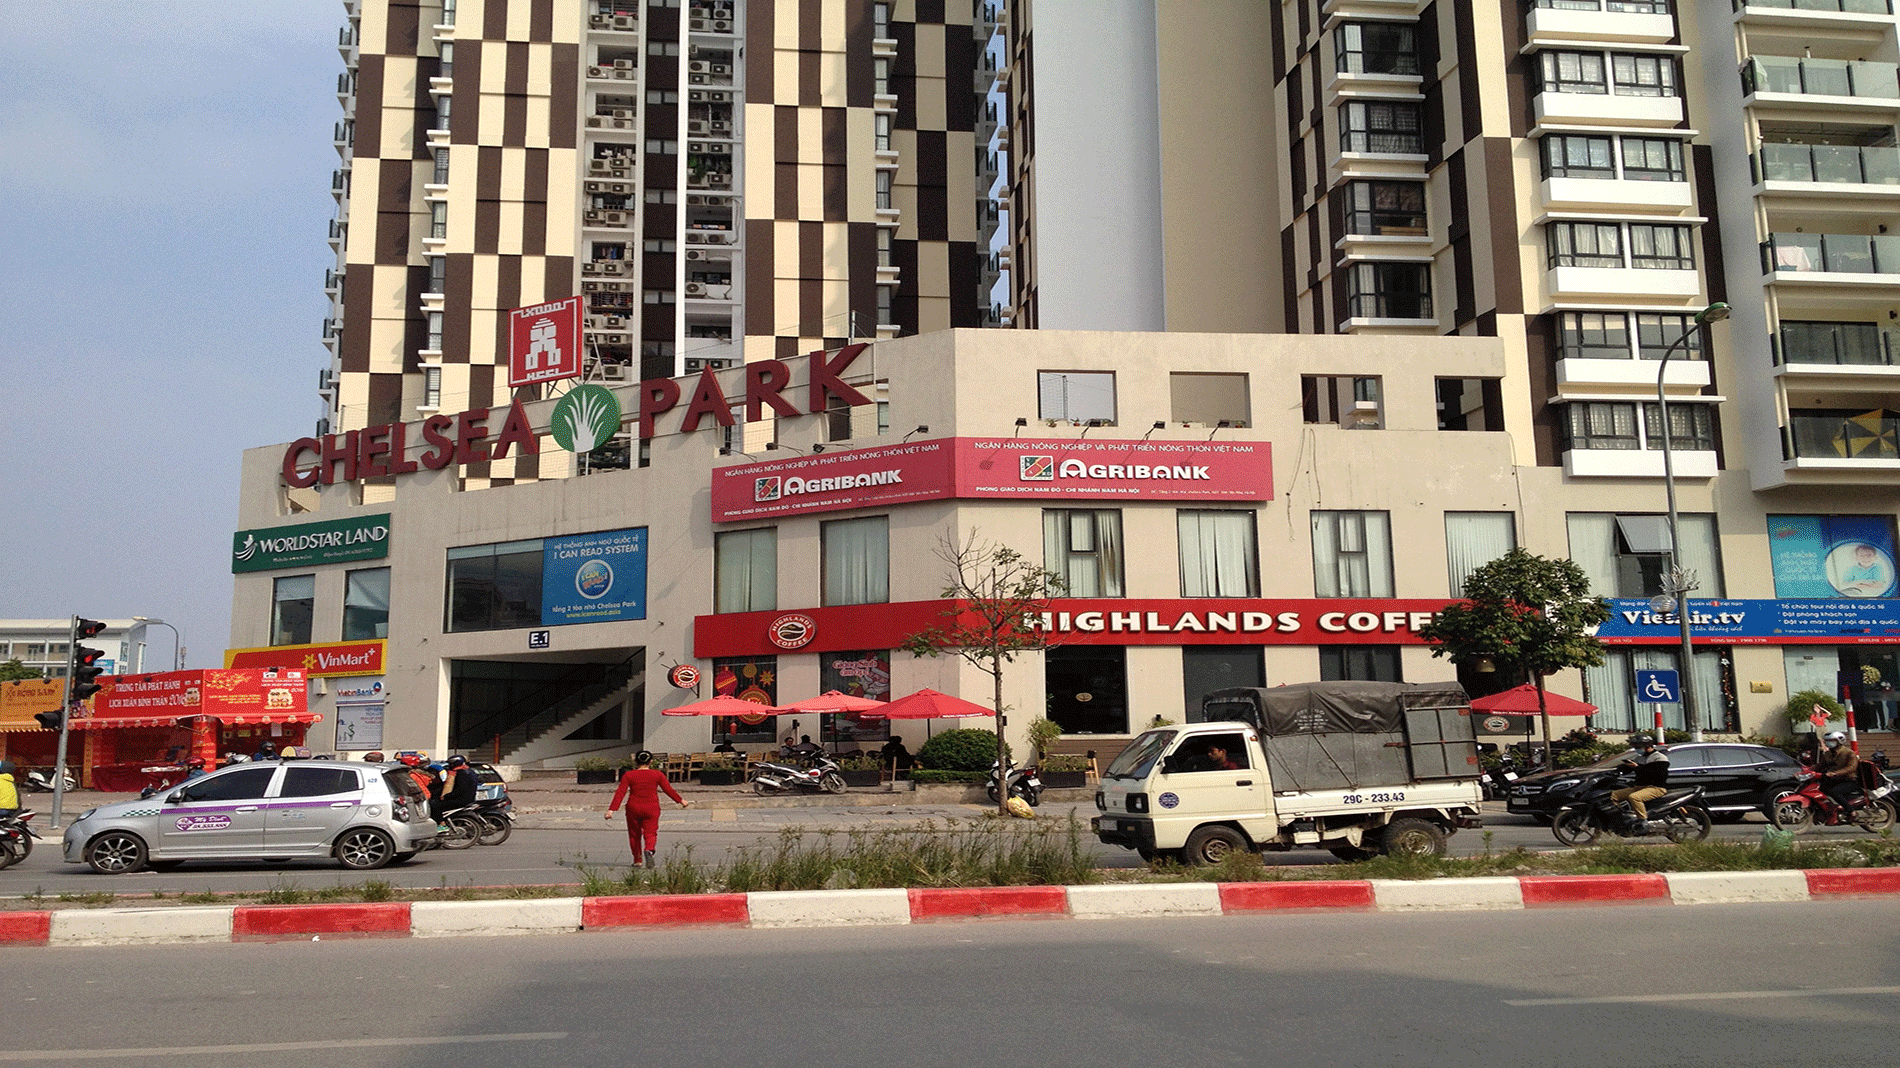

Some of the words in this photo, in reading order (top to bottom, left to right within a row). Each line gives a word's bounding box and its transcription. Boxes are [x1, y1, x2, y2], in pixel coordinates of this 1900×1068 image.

[282, 398, 541, 488] CHELSEA
[640, 342, 876, 439] PARK
[1003, 442, 1029, 450] HÀNG
[1032, 441, 1058, 450] NÔNG
[1061, 443, 1092, 451] NGHIỆP
[1108, 443, 1130, 451] PHÁT
[1132, 442, 1156, 452] TRIỂN
[1158, 443, 1185, 452] NÔNG
[1186, 444, 1211, 452] THÔN
[1213, 444, 1231, 453] VIỆT
[1233, 445, 1254, 453] NAM
[725, 468, 743, 477] NGÂN
[744, 465, 763, 474] HÀNG
[764, 463, 784, 472] NÔNG
[820, 456, 837, 464] PHÁT
[859, 450, 881, 460] NÔNG
[882, 447, 904, 457] THÔN
[921, 444, 940, 452] NAM
[1059, 459, 1210, 479] AGRIBANK
[783, 469, 903, 495] AGRIBANK
[260, 531, 343, 553] WORLDSTAR
[345, 526, 388, 545] LAND
[554, 551, 557, 559] I
[559, 549, 578, 559] CAN
[580, 547, 603, 557] READ
[605, 544, 639, 554] SYSTEM
[772, 616, 812, 631] HIGHLANDS
[1023, 611, 1300, 632] HIGHLANDS
[1319, 611, 1443, 632] COFF
[1623, 610, 1745, 625] Vieir.tv
[531, 632, 548, 645] E.1
[777, 637, 808, 647] COFFEE
[115, 683, 134, 692] TRUNG
[148, 680, 163, 690] PHÁT
[1343, 794, 1362, 804] 29C
[1371, 792, 1405, 803] 233.43
